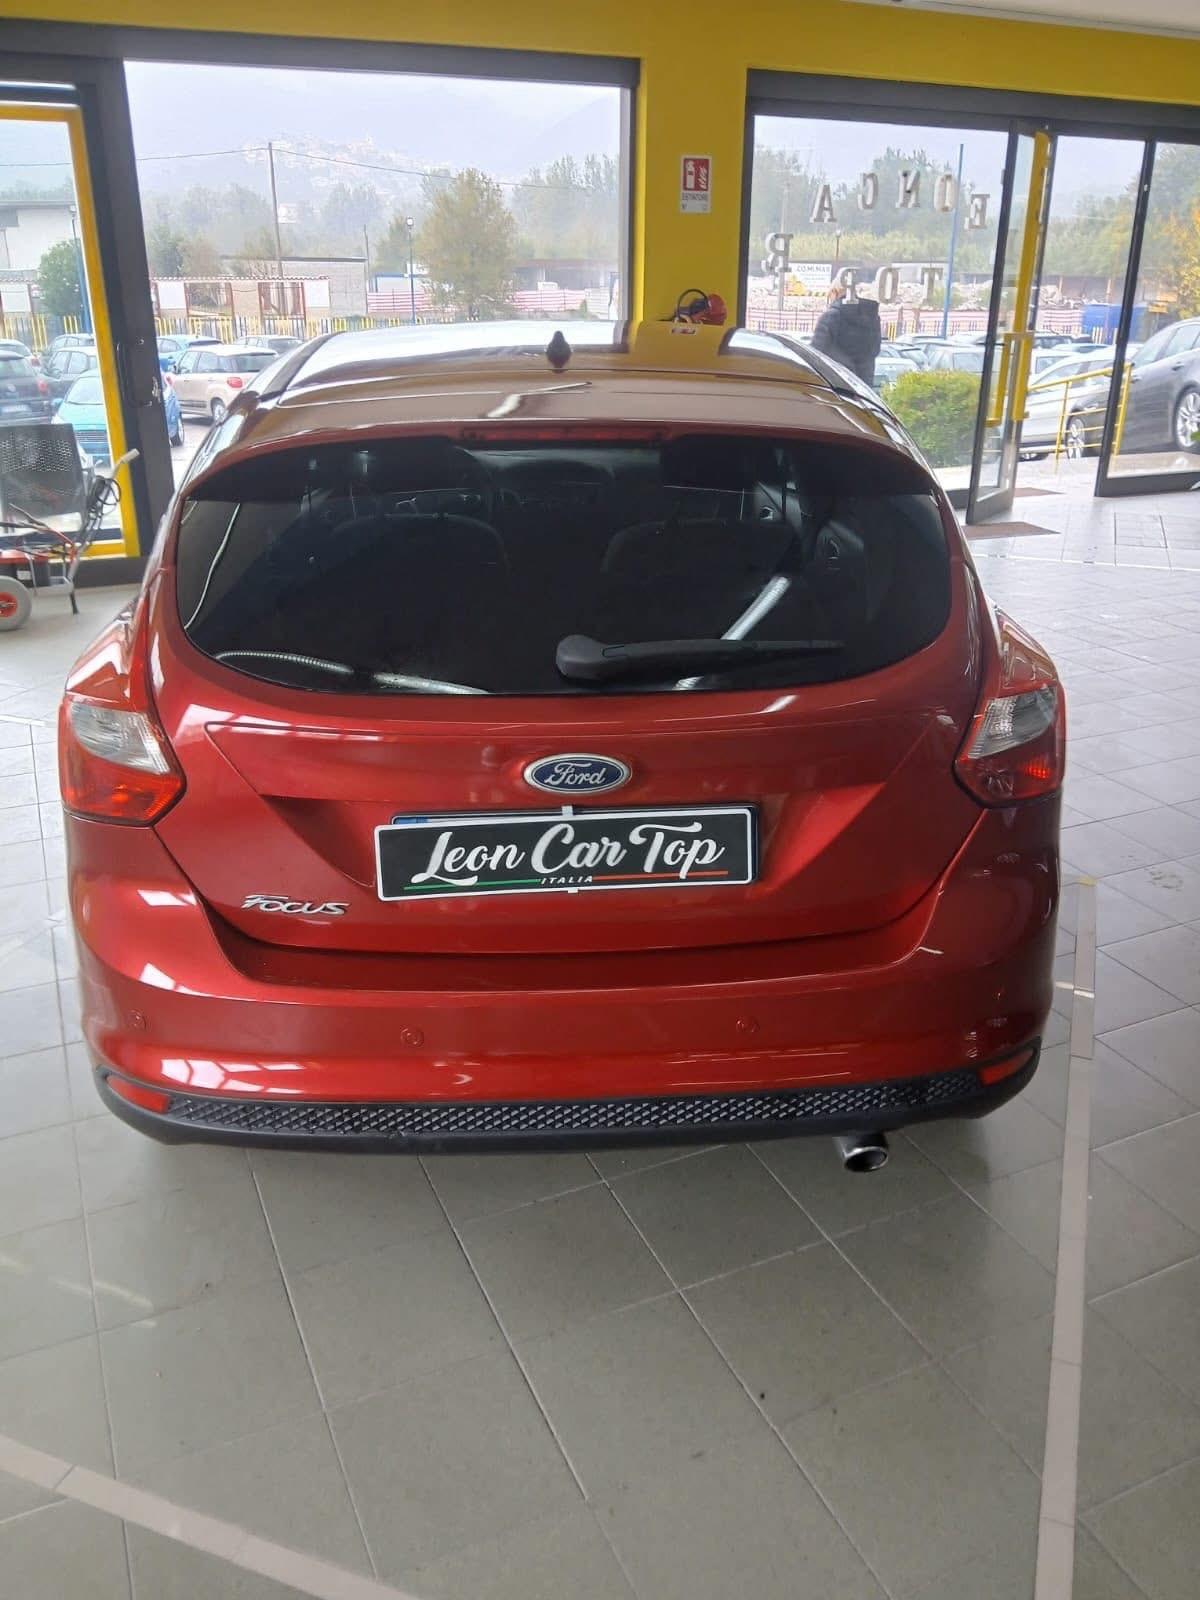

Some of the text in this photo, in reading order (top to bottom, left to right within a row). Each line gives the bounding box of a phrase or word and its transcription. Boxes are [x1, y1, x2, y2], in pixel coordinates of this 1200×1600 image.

[544, 762, 606, 785] Ford
[411, 821, 726, 886] Leon Car Top
[541, 875, 593, 885] ITALIA
